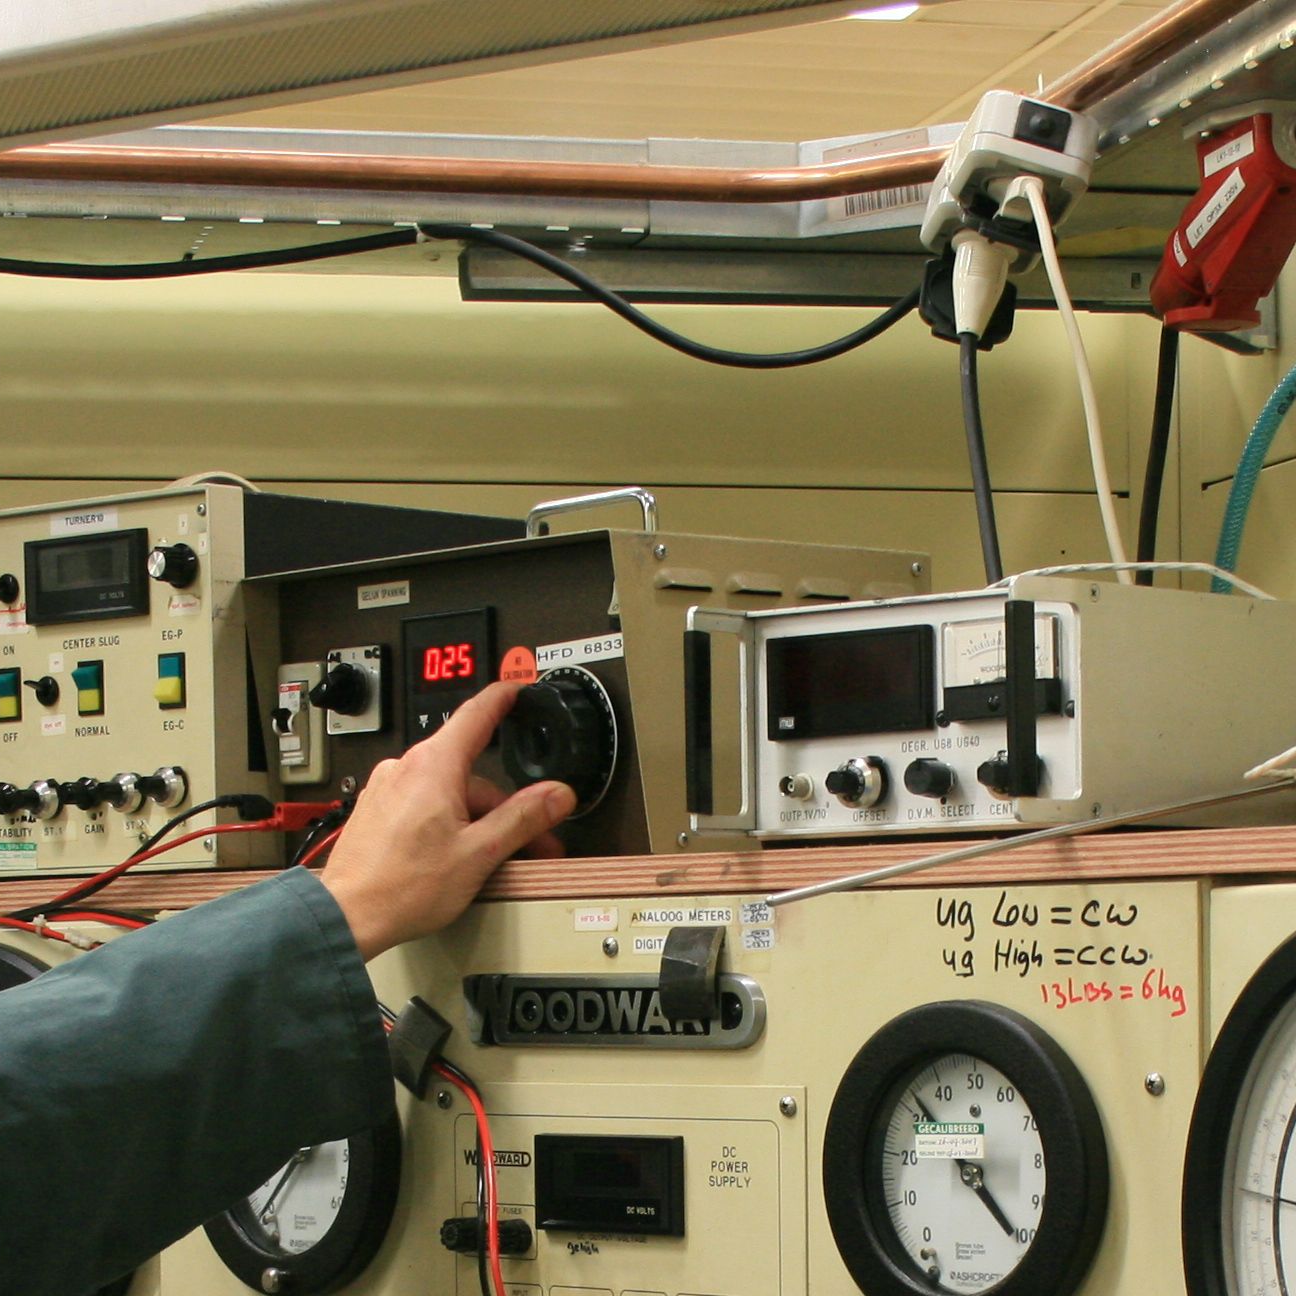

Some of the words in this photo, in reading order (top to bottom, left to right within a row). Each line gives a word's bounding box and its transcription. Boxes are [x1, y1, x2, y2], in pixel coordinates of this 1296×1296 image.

[162, 630, 183, 641] EG-P
[63, 637, 95, 650] CENTER
[98, 635, 120, 647] SLUG
[3, 646, 15, 656] ON
[537, 648, 574, 663] HFD
[584, 638, 623, 655] 6833
[423, 643, 475, 682] 025
[75, 725, 110, 737] NORMAL
[163, 719, 185, 731] EG-C
[3, 732, 18, 743] OFF
[84, 823, 105, 834] GAIN
[632, 910, 683, 922] ANALOOG
[689, 909, 731, 922] METERS
[635, 938, 664, 950] DIGIT
[994, 938, 1043, 977] High
[967, 1074, 984, 1090] 50
[935, 1085, 952, 1101] 40
[996, 1086, 1015, 1102] 60
[918, 1123, 980, 1135] GECALIBREERD
[723, 1146, 736, 1158] DC
[902, 1150, 918, 1165] 20
[710, 1161, 748, 1174] POWER
[708, 1176, 751, 1188] SUPPLY
[904, 1190, 917, 1206] 10
[922, 1226, 932, 1242] 0
